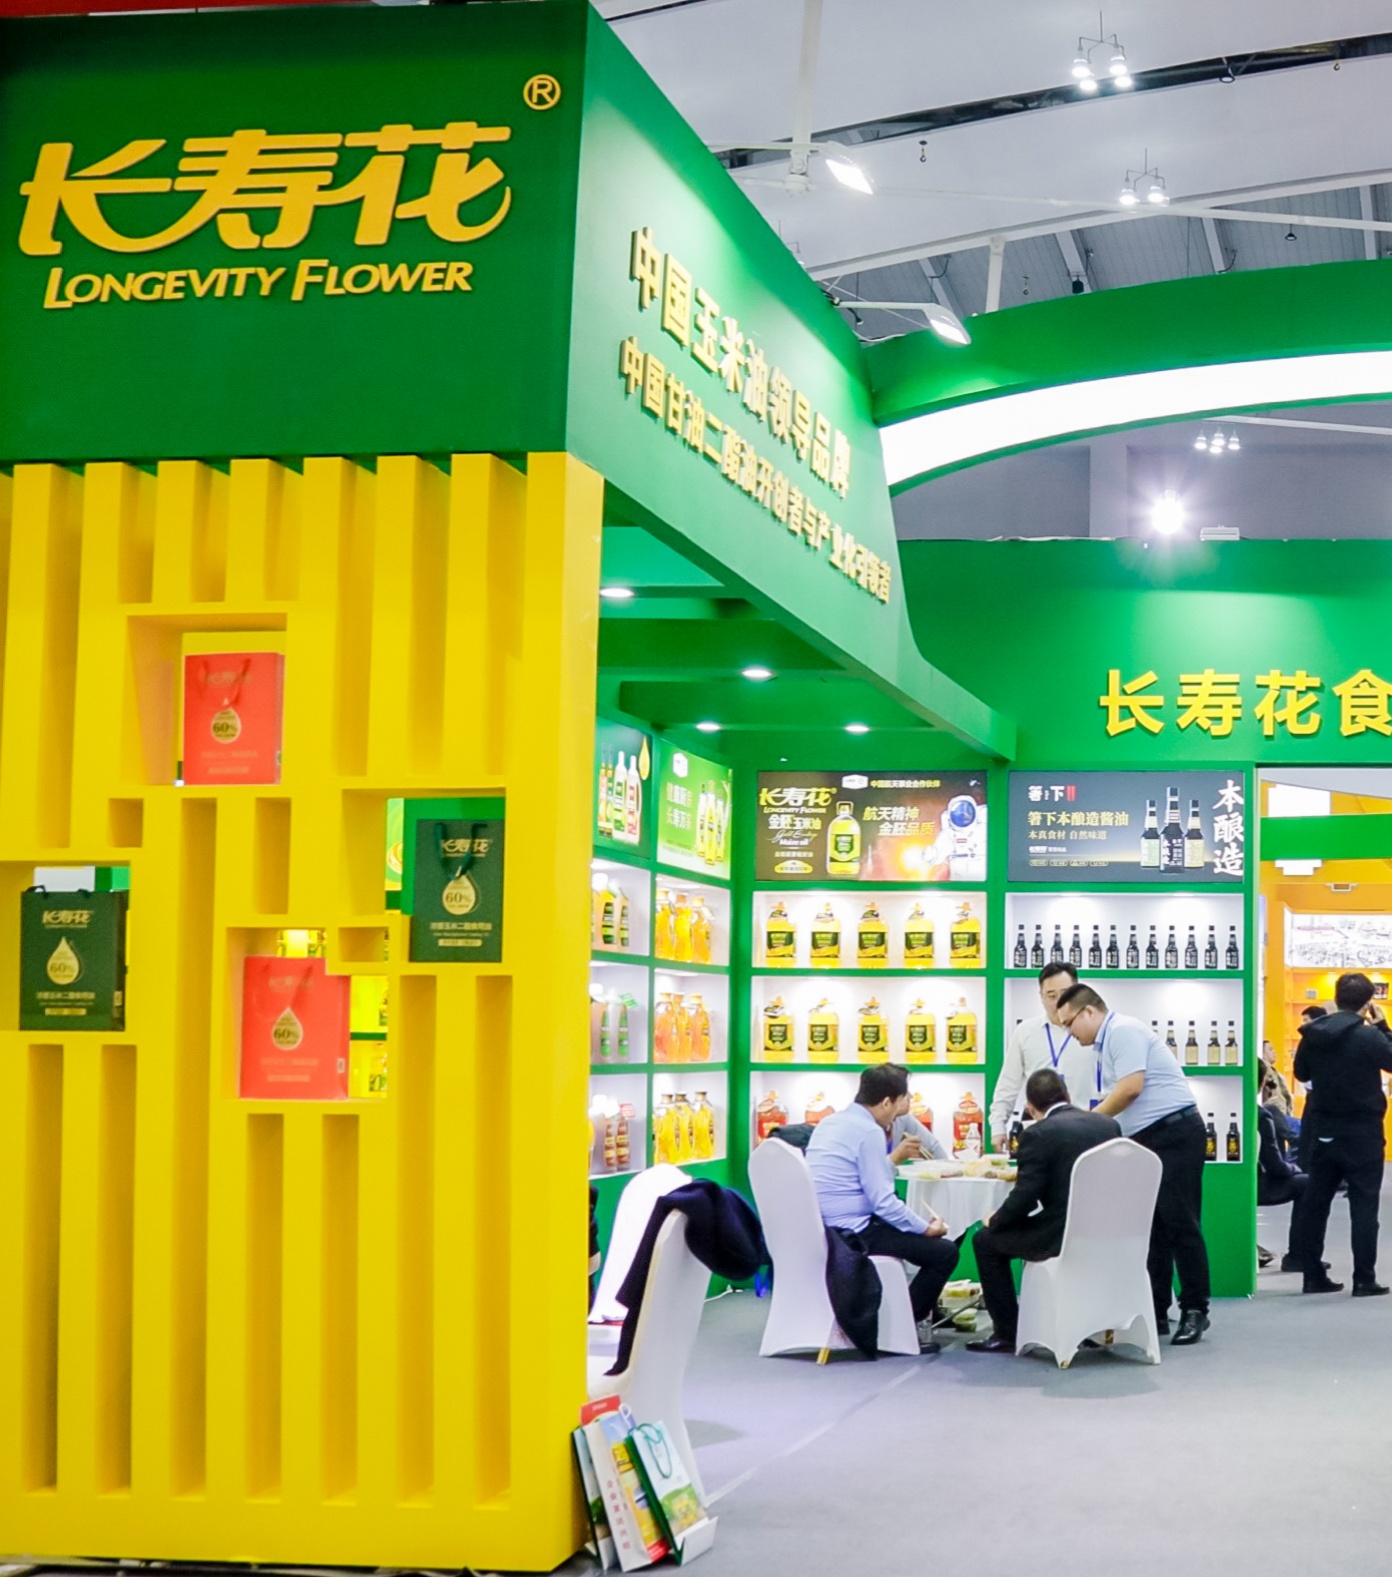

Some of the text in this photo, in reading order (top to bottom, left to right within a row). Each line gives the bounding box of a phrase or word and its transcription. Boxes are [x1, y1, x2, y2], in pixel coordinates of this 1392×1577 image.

[18, 121, 512, 256] 长寿花
[43, 259, 474, 309] LONGEVITY FLOWER
[630, 227, 851, 499] 中国玉米油领导品牌
[759, 787, 832, 806] 长寿花
[863, 806, 920, 821] 航天精神
[877, 822, 935, 836] 金胚品质
[1027, 811, 1130, 827] 箸下本酿造酱油
[1212, 779, 1245, 876] 本酿造
